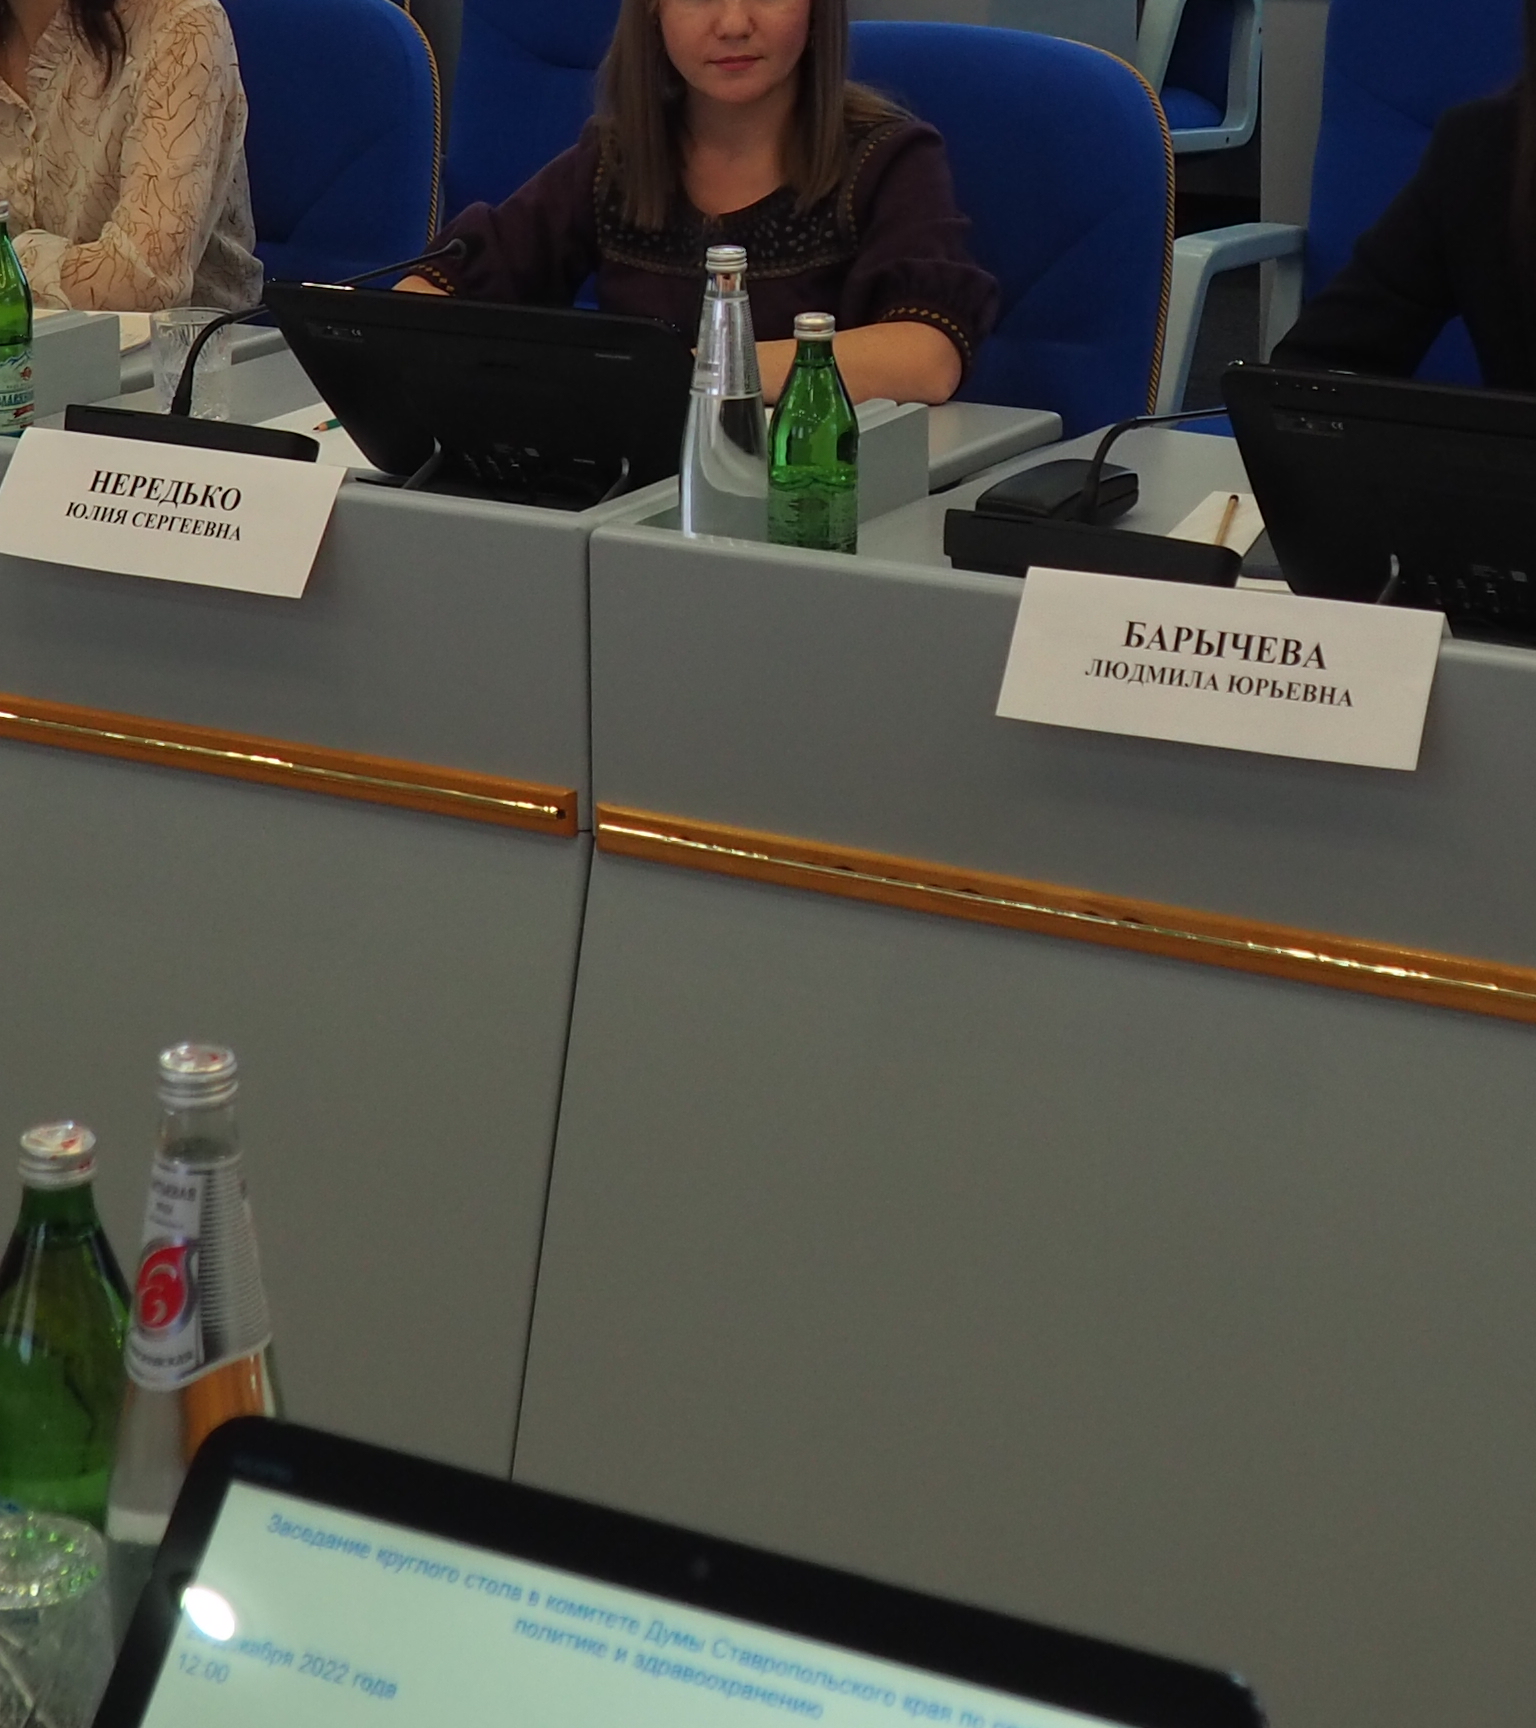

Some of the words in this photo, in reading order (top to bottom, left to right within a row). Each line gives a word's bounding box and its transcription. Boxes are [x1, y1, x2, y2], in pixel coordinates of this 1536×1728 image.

[87, 469, 242, 512] НЕРЕДЬКО
[64, 501, 128, 526] ЮЛИЯ
[131, 509, 242, 543] СЕРГЕЕВНА
[1122, 620, 1327, 670] БАРЫЧЕВА
[1085, 658, 1219, 691] ЛЮДМИЛА
[1227, 674, 1353, 707] ЮРЬЕВНА
[267, 1512, 371, 1560] Заседание
[375, 1547, 460, 1588] круглого
[464, 1571, 522, 1603] стола
[527, 1589, 541, 1608] в
[545, 1593, 640, 1636] комитете
[643, 1618, 706, 1654] Думы
[711, 1636, 897, 1709] Ставропольского
[902, 1694, 954, 1724] края
[297, 1651, 349, 1685] 2022
[352, 1673, 399, 1702] года
[514, 1616, 609, 1660] политике
[613, 1646, 628, 1665] и
[633, 1651, 824, 1721] здравоохранению
